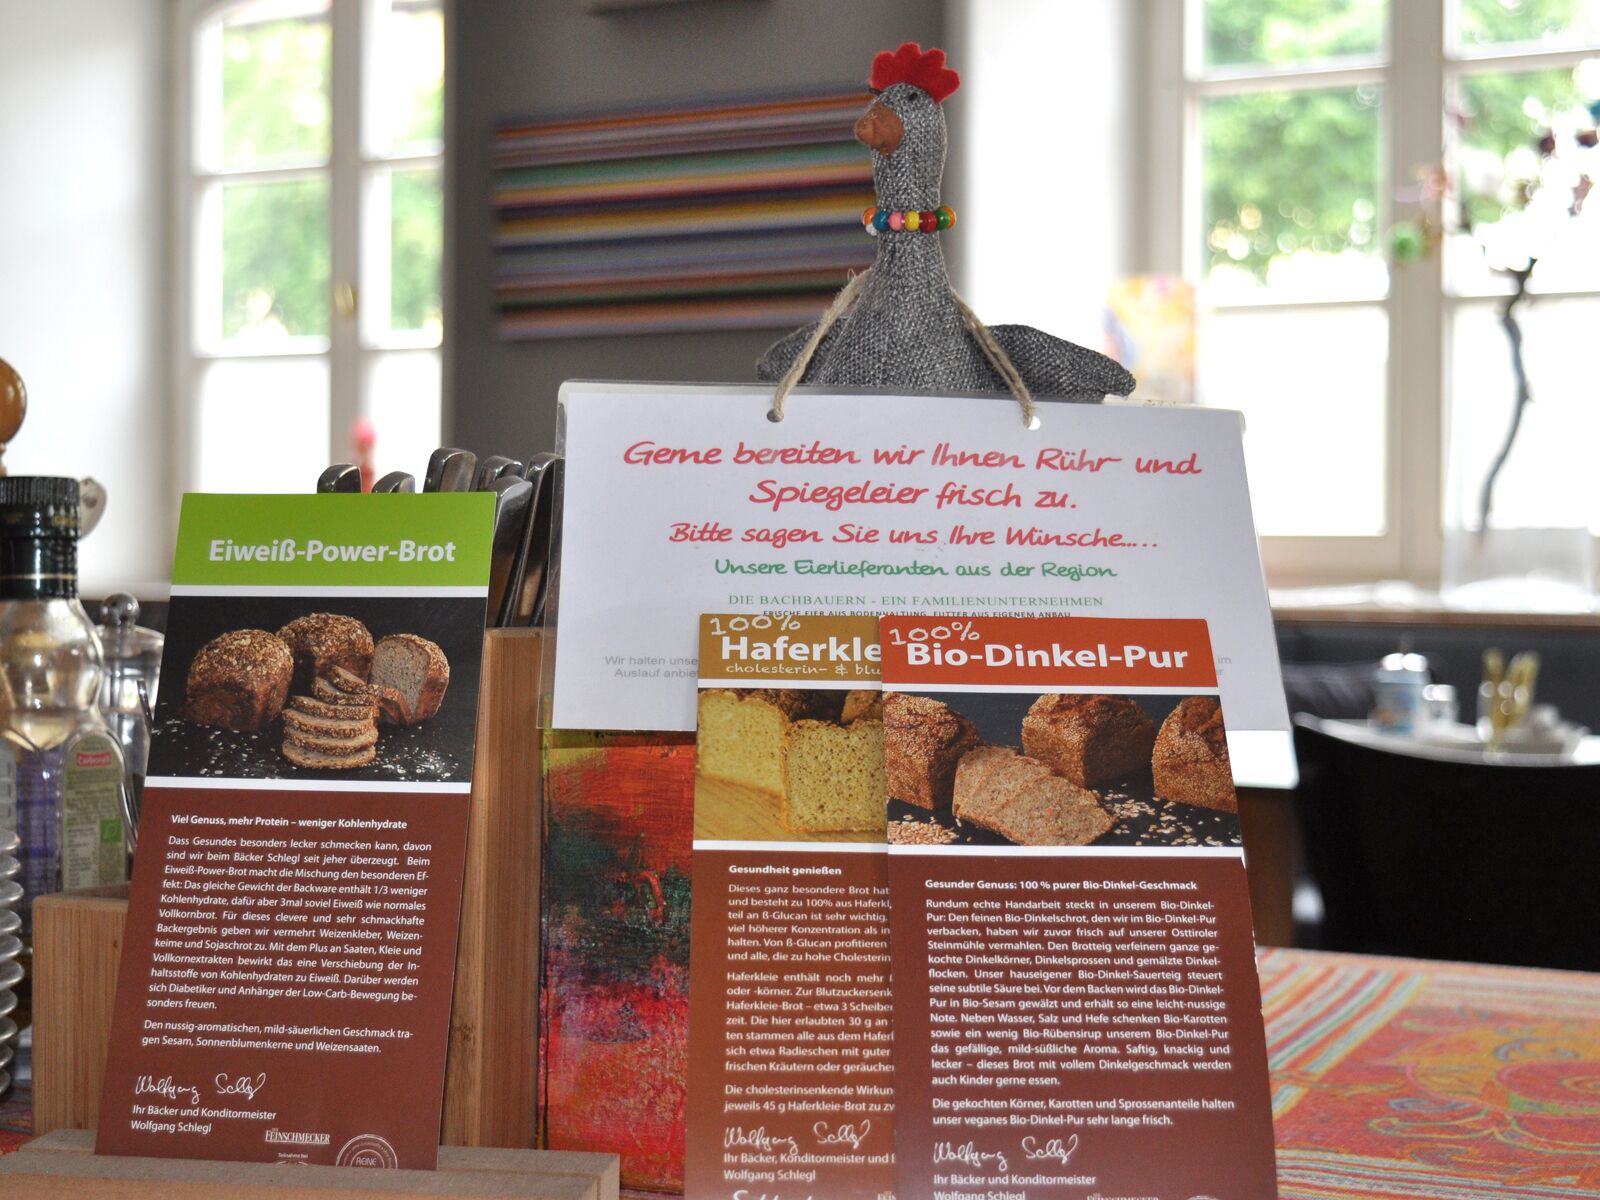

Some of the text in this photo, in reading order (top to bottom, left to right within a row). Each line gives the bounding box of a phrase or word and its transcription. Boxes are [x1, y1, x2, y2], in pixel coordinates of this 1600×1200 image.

[733, 441, 861, 465] bereiten
[873, 445, 925, 465] wir
[931, 444, 1026, 469] Ihnen
[1135, 452, 1203, 475] und
[749, 479, 1076, 512] Spiegeleier frisch zu.
[669, 522, 733, 543] Bitte
[741, 528, 824, 549] sagen
[832, 523, 880, 543] Sie
[889, 529, 938, 544] uns
[949, 525, 995, 545] Ihre
[209, 539, 456, 562] Eiweiß-Power-Brot
[715, 559, 1118, 582] Unsere Eierlieferanten aus der Region
[729, 595, 754, 605] DIE
[760, 595, 865, 605] BACHBAUERN
[881, 596, 906, 605] EIN
[912, 596, 1103, 606] FAMILIENUNTERNEHMEN
[709, 612, 801, 636] 100%
[889, 621, 980, 646] 100%
[721, 635, 881, 662] Haferkle
[906, 643, 1189, 668] Bio-Dinkel-Pur
[604, 656, 624, 664] Wir
[629, 656, 666, 664] halten
[614, 668, 660, 678] Auslauf
[725, 662, 828, 674] cholesterin-
[834, 663, 848, 676] &
[171, 815, 189, 824] Viel
[190, 815, 226, 825] Genuss,
[228, 816, 254, 825] mehr
[255, 816, 289, 826] Protein
[298, 818, 337, 829] weniger
[338, 819, 407, 831] Kohlenhydrate
[168, 835, 432, 851] Dass Gesundes besonders lecker schmecken kann, davon
[166, 850, 430, 867] sind wir beim Bäcker Schlegl seit jeher überzeugt. Beim
[729, 865, 842, 876] Gesundheit genießen
[729, 884, 761, 893] Dieses
[764, 886, 789, 895] ganz
[792, 885, 846, 894] besondere
[849, 886, 869, 895] Brot
[925, 879, 1197, 891] Gesunder Genuss: 100 % purer Bio-Dinkel-Geschmack
[728, 897, 749, 906] und
[751, 897, 788, 906] besteht
[806, 899, 833, 907] 100%
[926, 899, 1214, 910] Rundum echte Handarbeit steckt in unserem Bio-Dinkel-
[927, 912, 1216, 924] Pur: Den feinen Bio-Dinkelschrot, den wir im Bio-Dinkel-Pur
[927, 926, 981, 937] verbacken,
[986, 927, 1018, 936] haben
[1023, 928, 1039, 936] wir
[1044, 929, 1072, 937] zuvor
[1076, 927, 1104, 937] frisch
[1108, 927, 1124, 937] auf
[1171, 928, 1218, 938] Osttiroler
[932, 1098, 1235, 1111] Die gekochten Körner, Karotten und Sprossenanteile halten
[132, 1104, 277, 1120] Ihr Bäcker und Konditormeister
[131, 1120, 212, 1135] Wolfgang Schlegl
[933, 1114, 1173, 1128] unser veganes Bio-Dinkel-Pur sehr lange frisch.
[724, 1152, 738, 1163] Ihr
[740, 1152, 778, 1164] Bäcker,
[780, 1152, 865, 1164] Konditormeister
[868, 1153, 890, 1163] und
[724, 1169, 816, 1183] Wolfgang Schlegl
[934, 1174, 1096, 1185] Ihr Bäcker und Konditormeister
